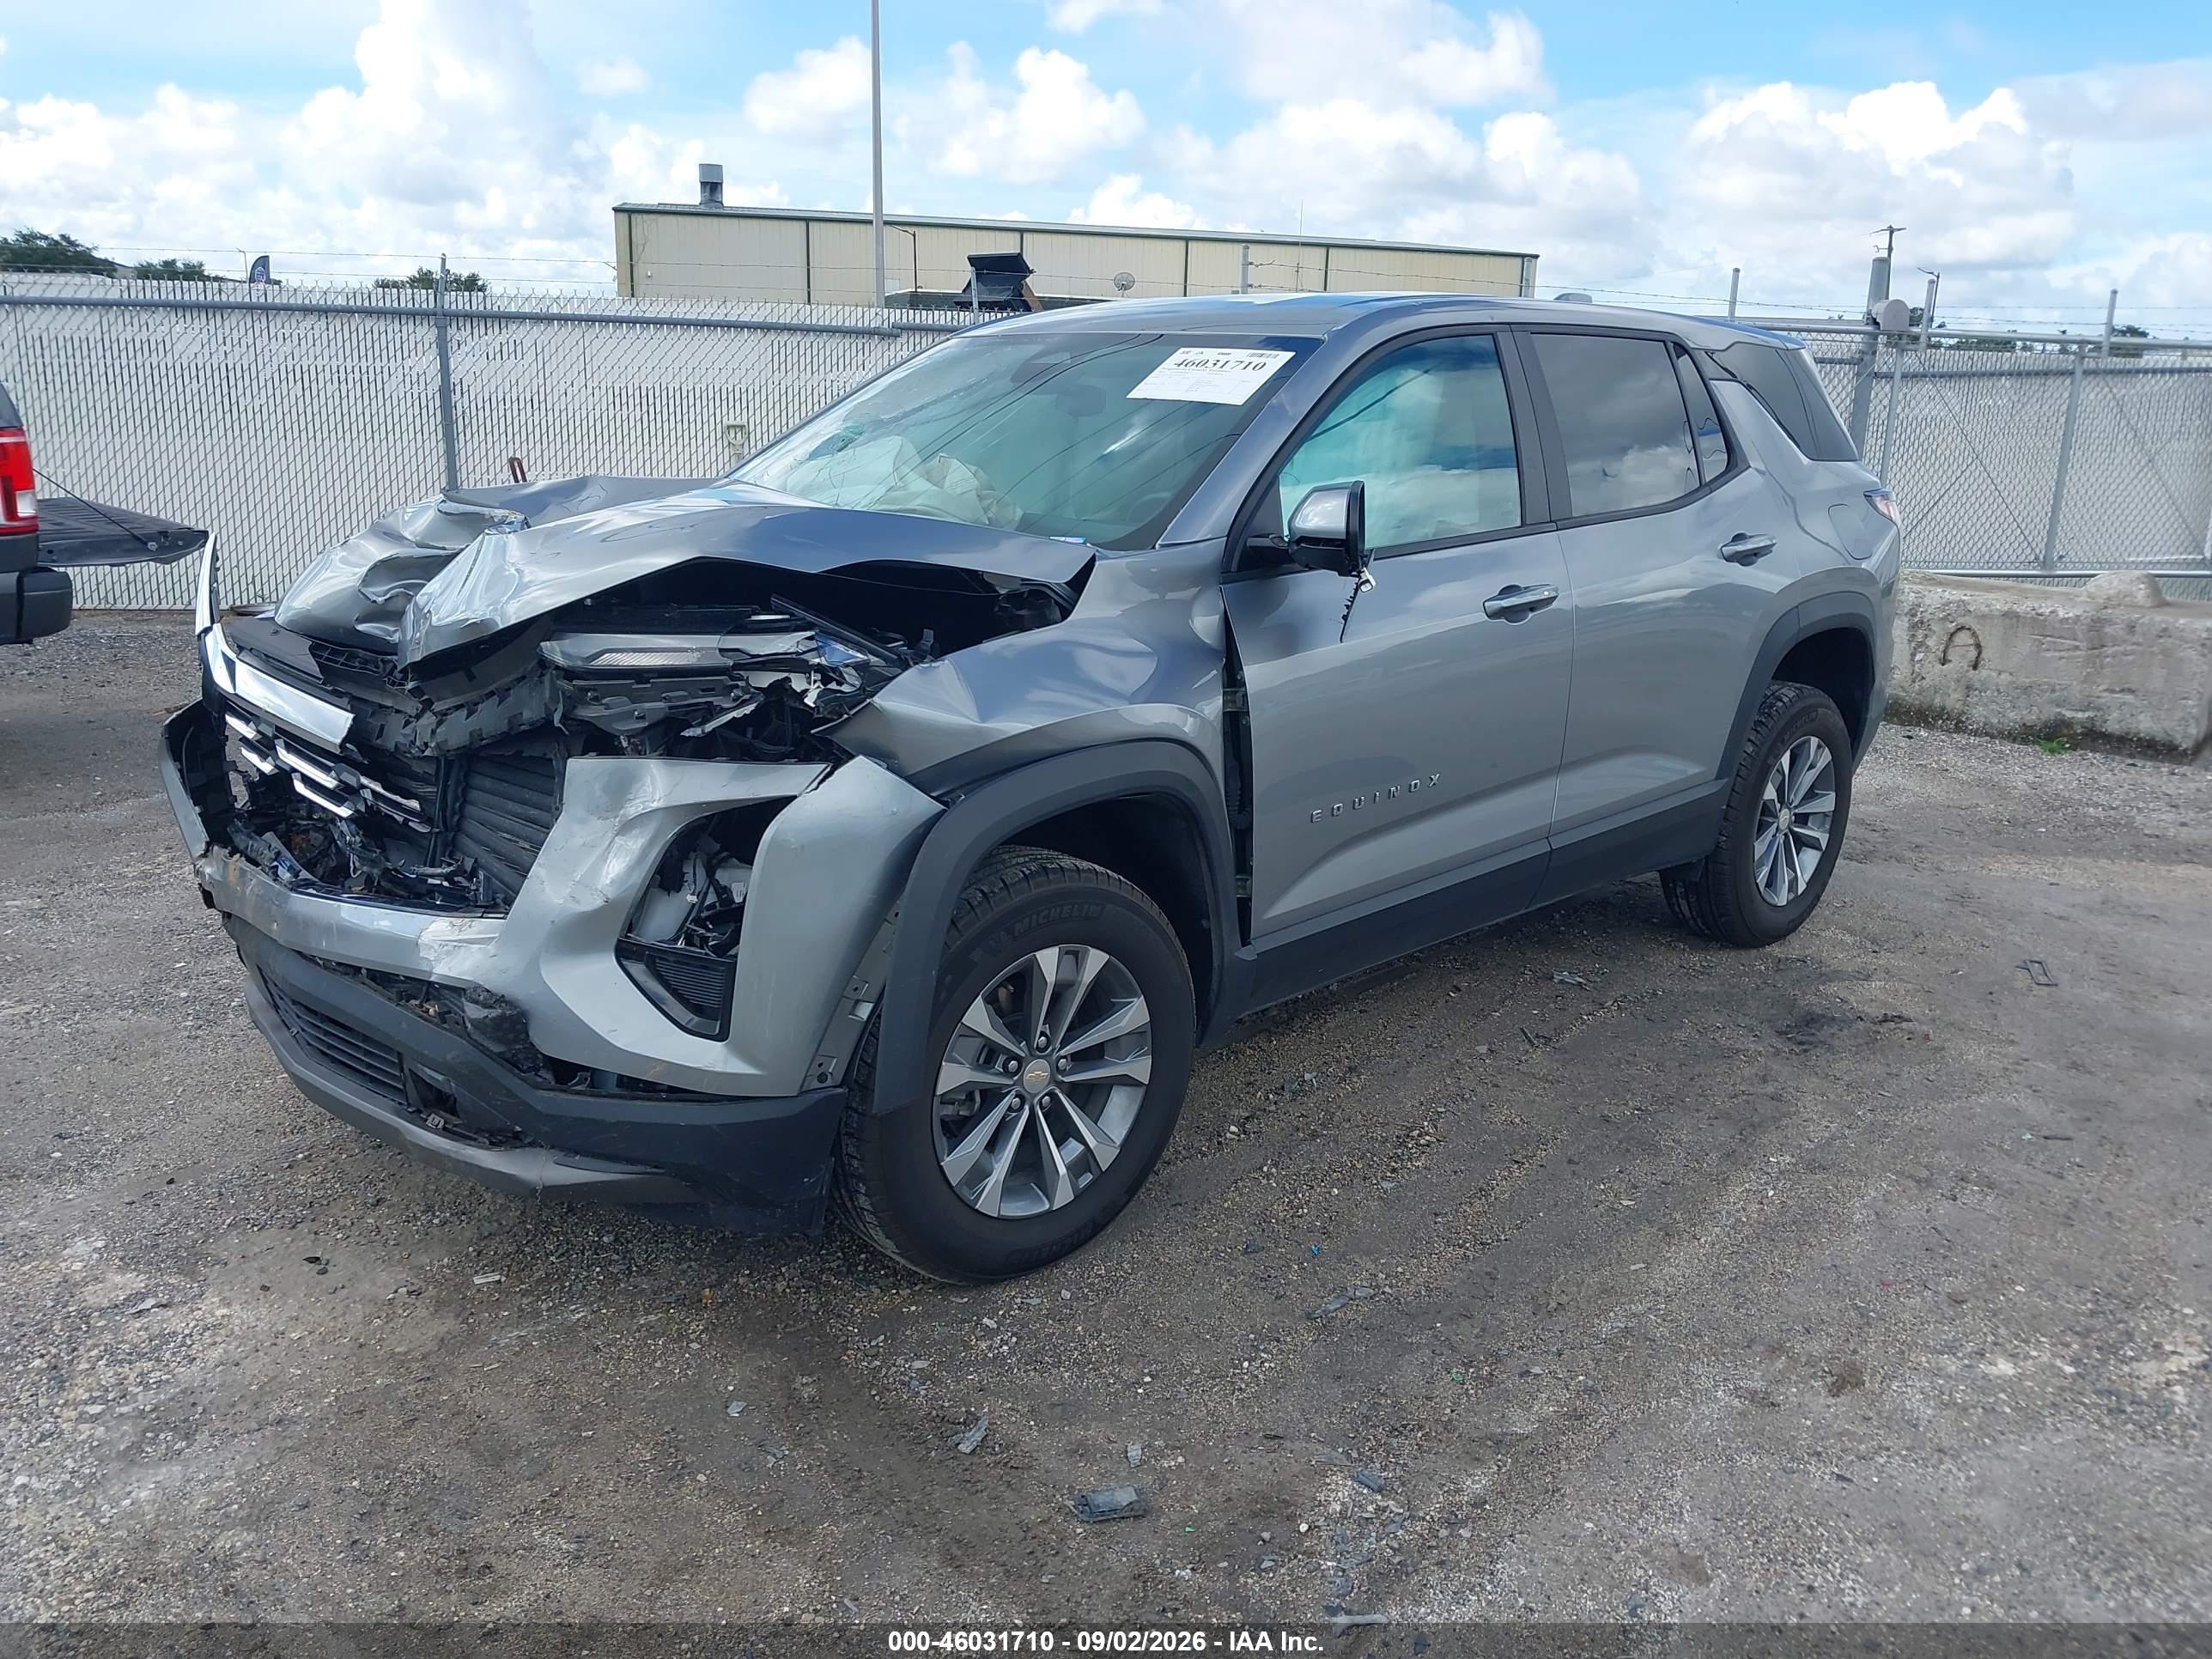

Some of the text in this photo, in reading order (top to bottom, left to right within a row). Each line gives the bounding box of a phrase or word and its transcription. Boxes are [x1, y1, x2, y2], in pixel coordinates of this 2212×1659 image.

[1174, 358, 1267, 371] 46031710
[1310, 773, 1441, 823] EQUINOX
[1013, 904, 1103, 937] MICHELIN
